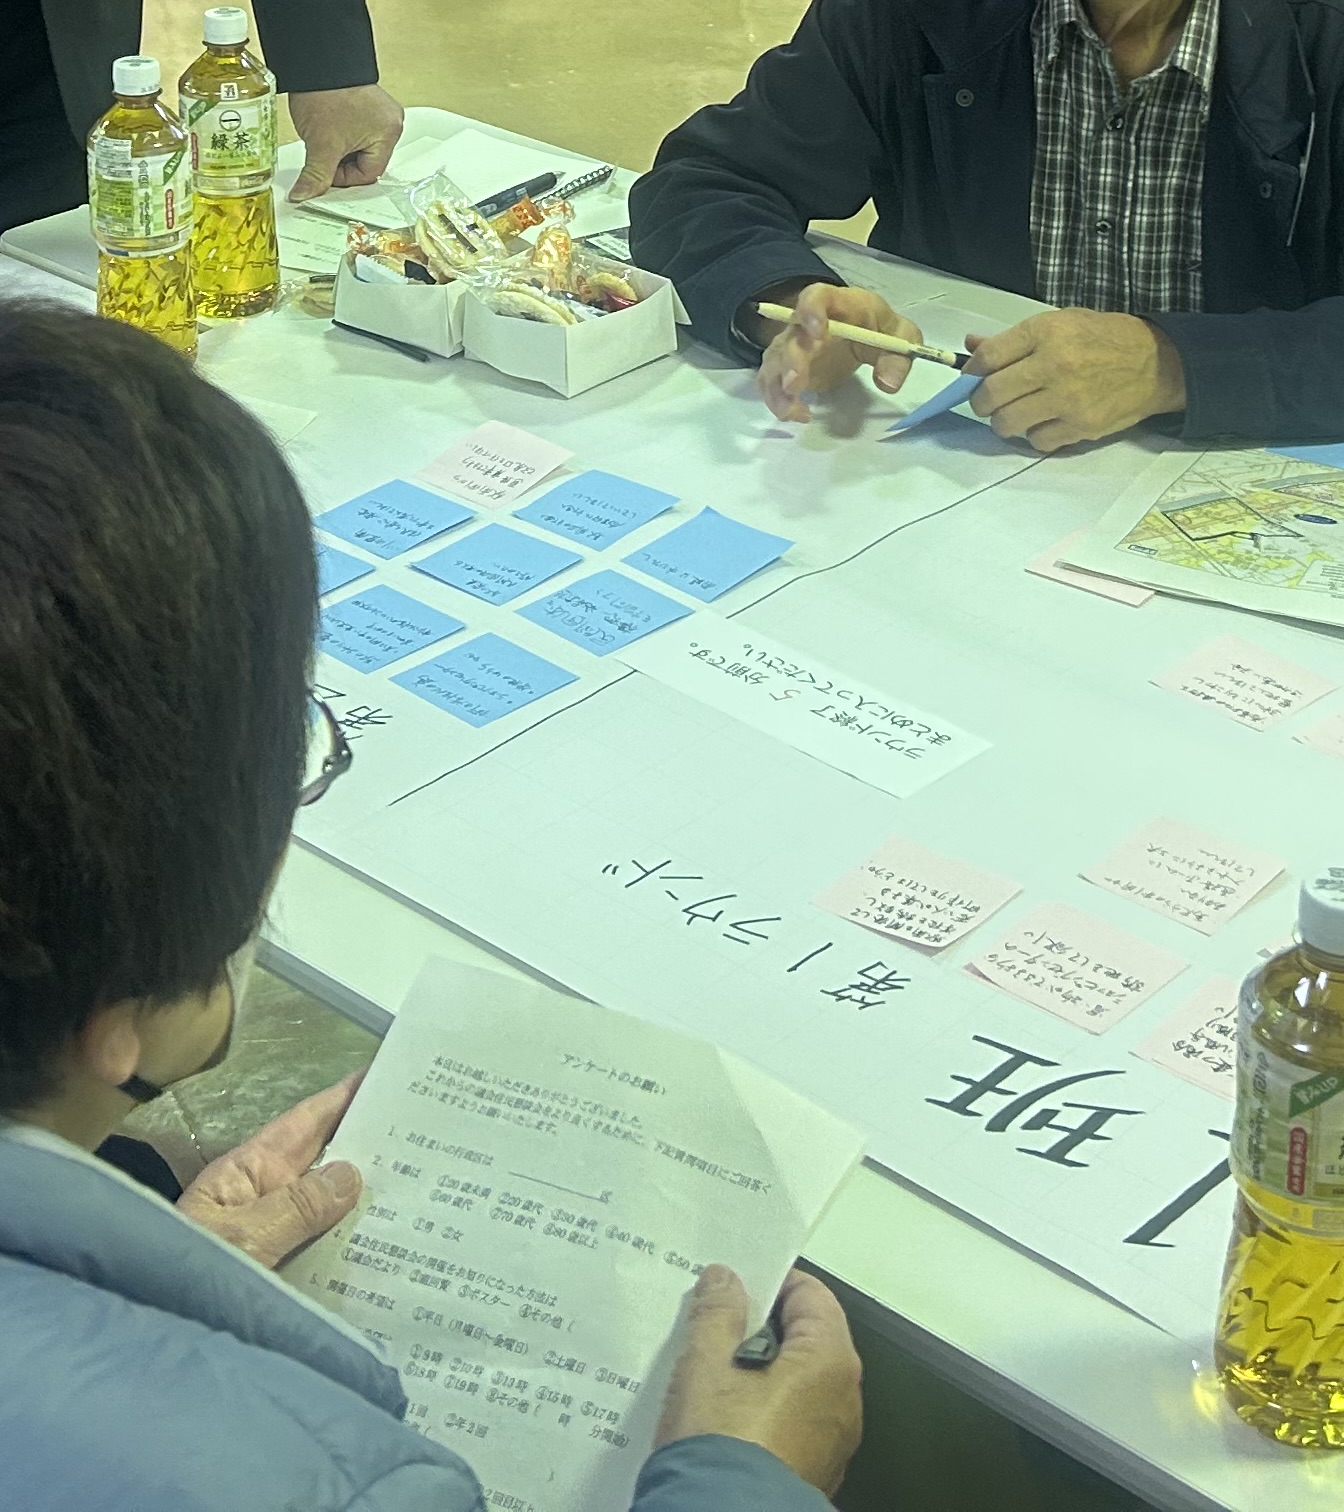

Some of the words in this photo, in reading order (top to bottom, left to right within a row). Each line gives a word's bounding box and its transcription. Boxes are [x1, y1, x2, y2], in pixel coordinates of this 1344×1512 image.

[211, 131, 250, 151] 緑茶
[687, 641, 764, 686] 分前です。
[742, 642, 953, 747] まとめに入ってください。
[809, 703, 927, 761] ラウンド終了
[602, 859, 912, 1011] 第1ラウンド
[560, 1051, 667, 1096] アンケートのお願い
